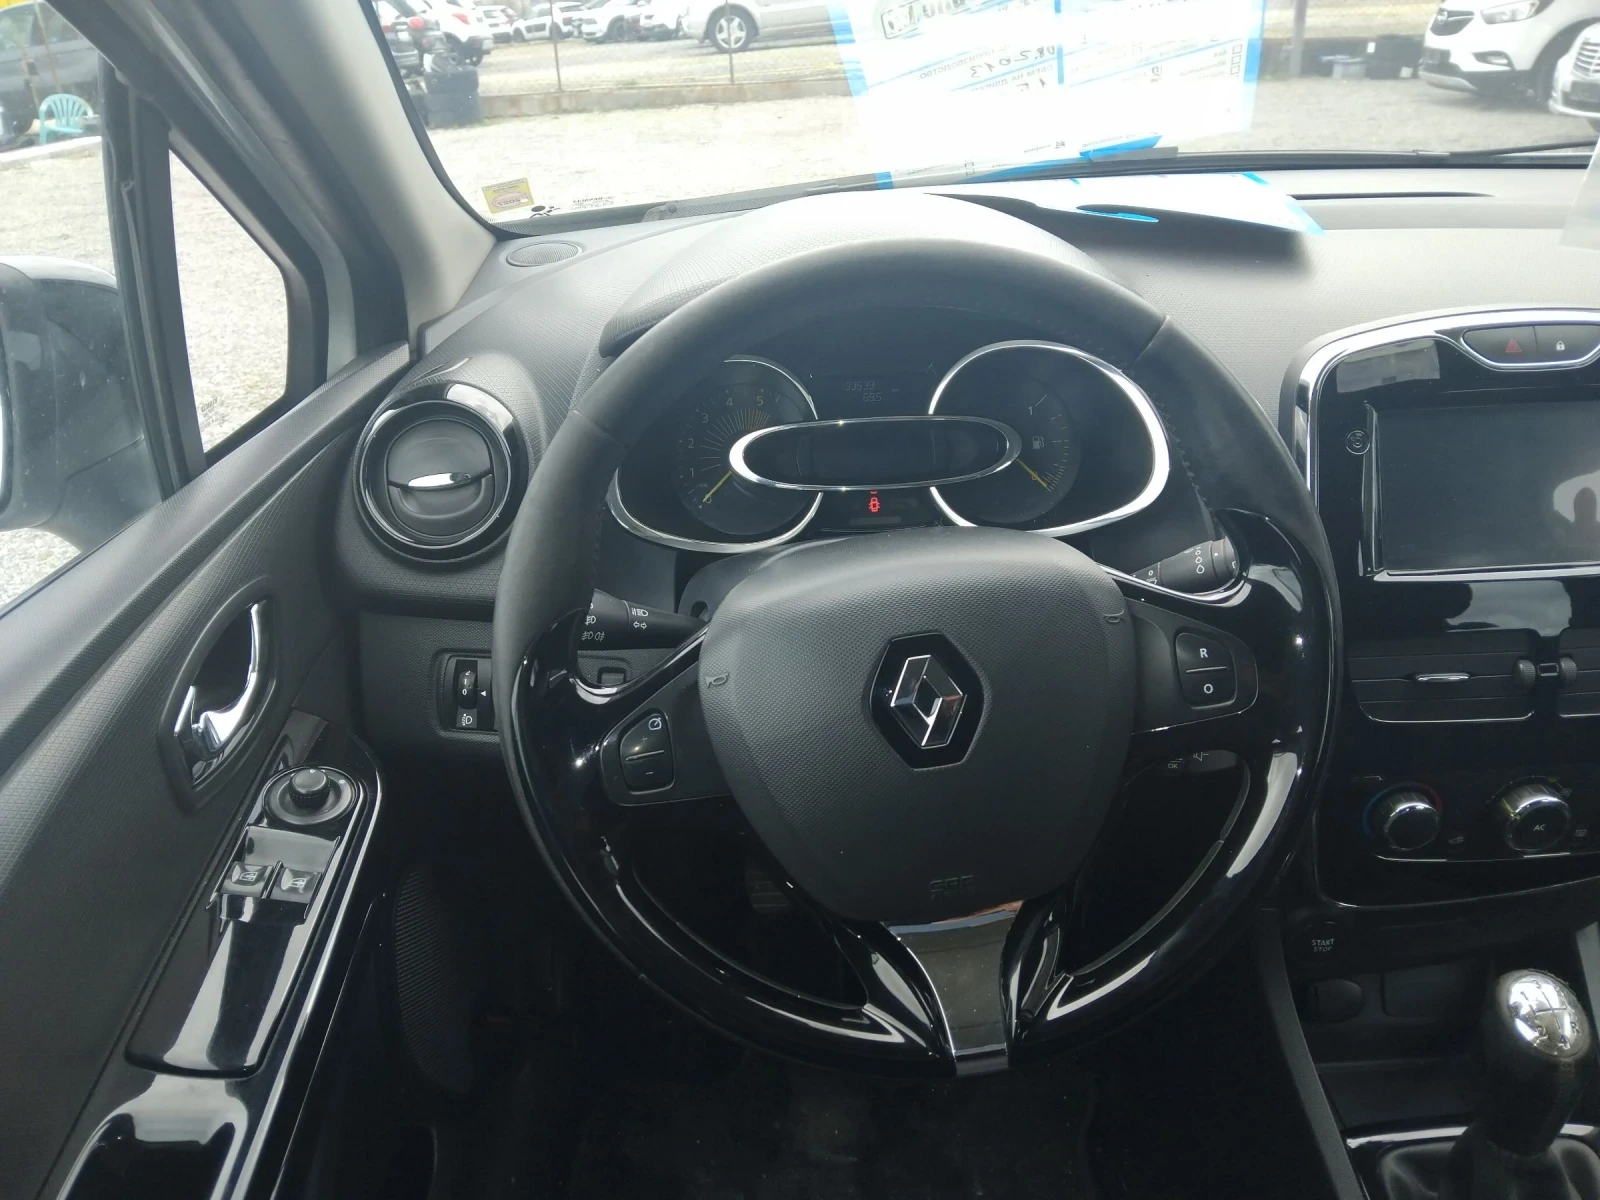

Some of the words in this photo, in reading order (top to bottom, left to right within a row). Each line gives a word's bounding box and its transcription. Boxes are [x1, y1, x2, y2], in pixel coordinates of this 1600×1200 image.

[725, 396, 734, 408] 4
[756, 395, 765, 407] 5
[1027, 405, 1034, 416] 1
[700, 412, 710, 424] 3
[687, 438, 695, 449] 2
[688, 467, 695, 478] 1
[1199, 648, 1209, 659] R
[1533, 824, 1546, 832] AC
[1311, 938, 1335, 947] START
